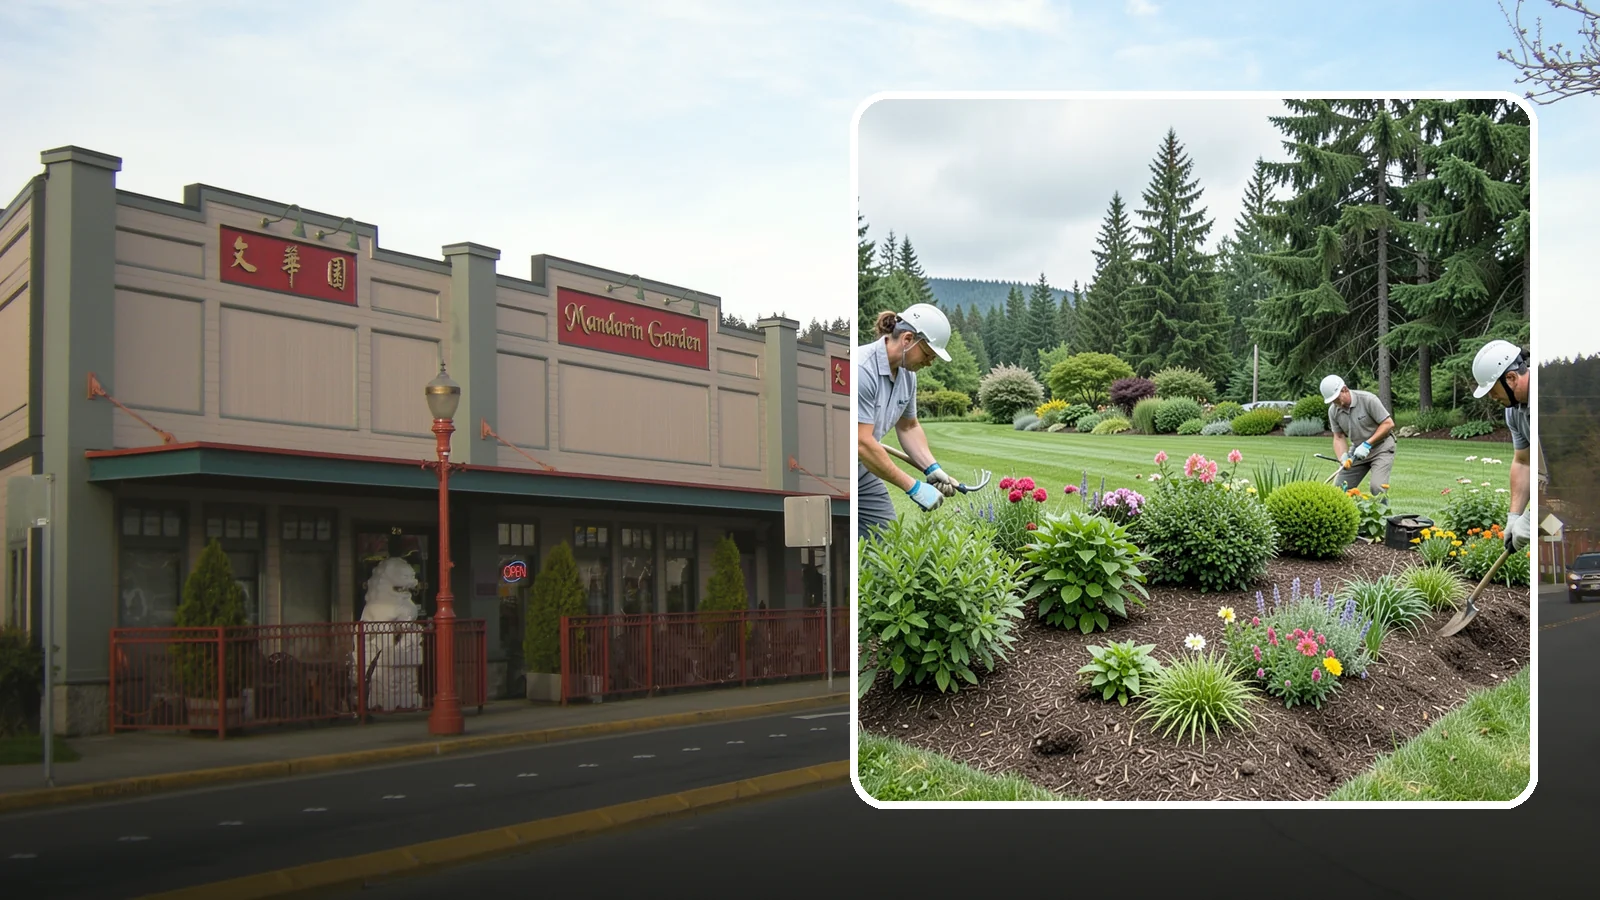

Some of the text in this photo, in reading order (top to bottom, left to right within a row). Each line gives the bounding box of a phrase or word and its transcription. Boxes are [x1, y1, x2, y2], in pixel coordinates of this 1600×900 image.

[231, 236, 346, 291] 文華園
[565, 302, 701, 352] Mandarin Garden
[835, 363, 846, 386] 文
[503, 565, 527, 578] OPEN
